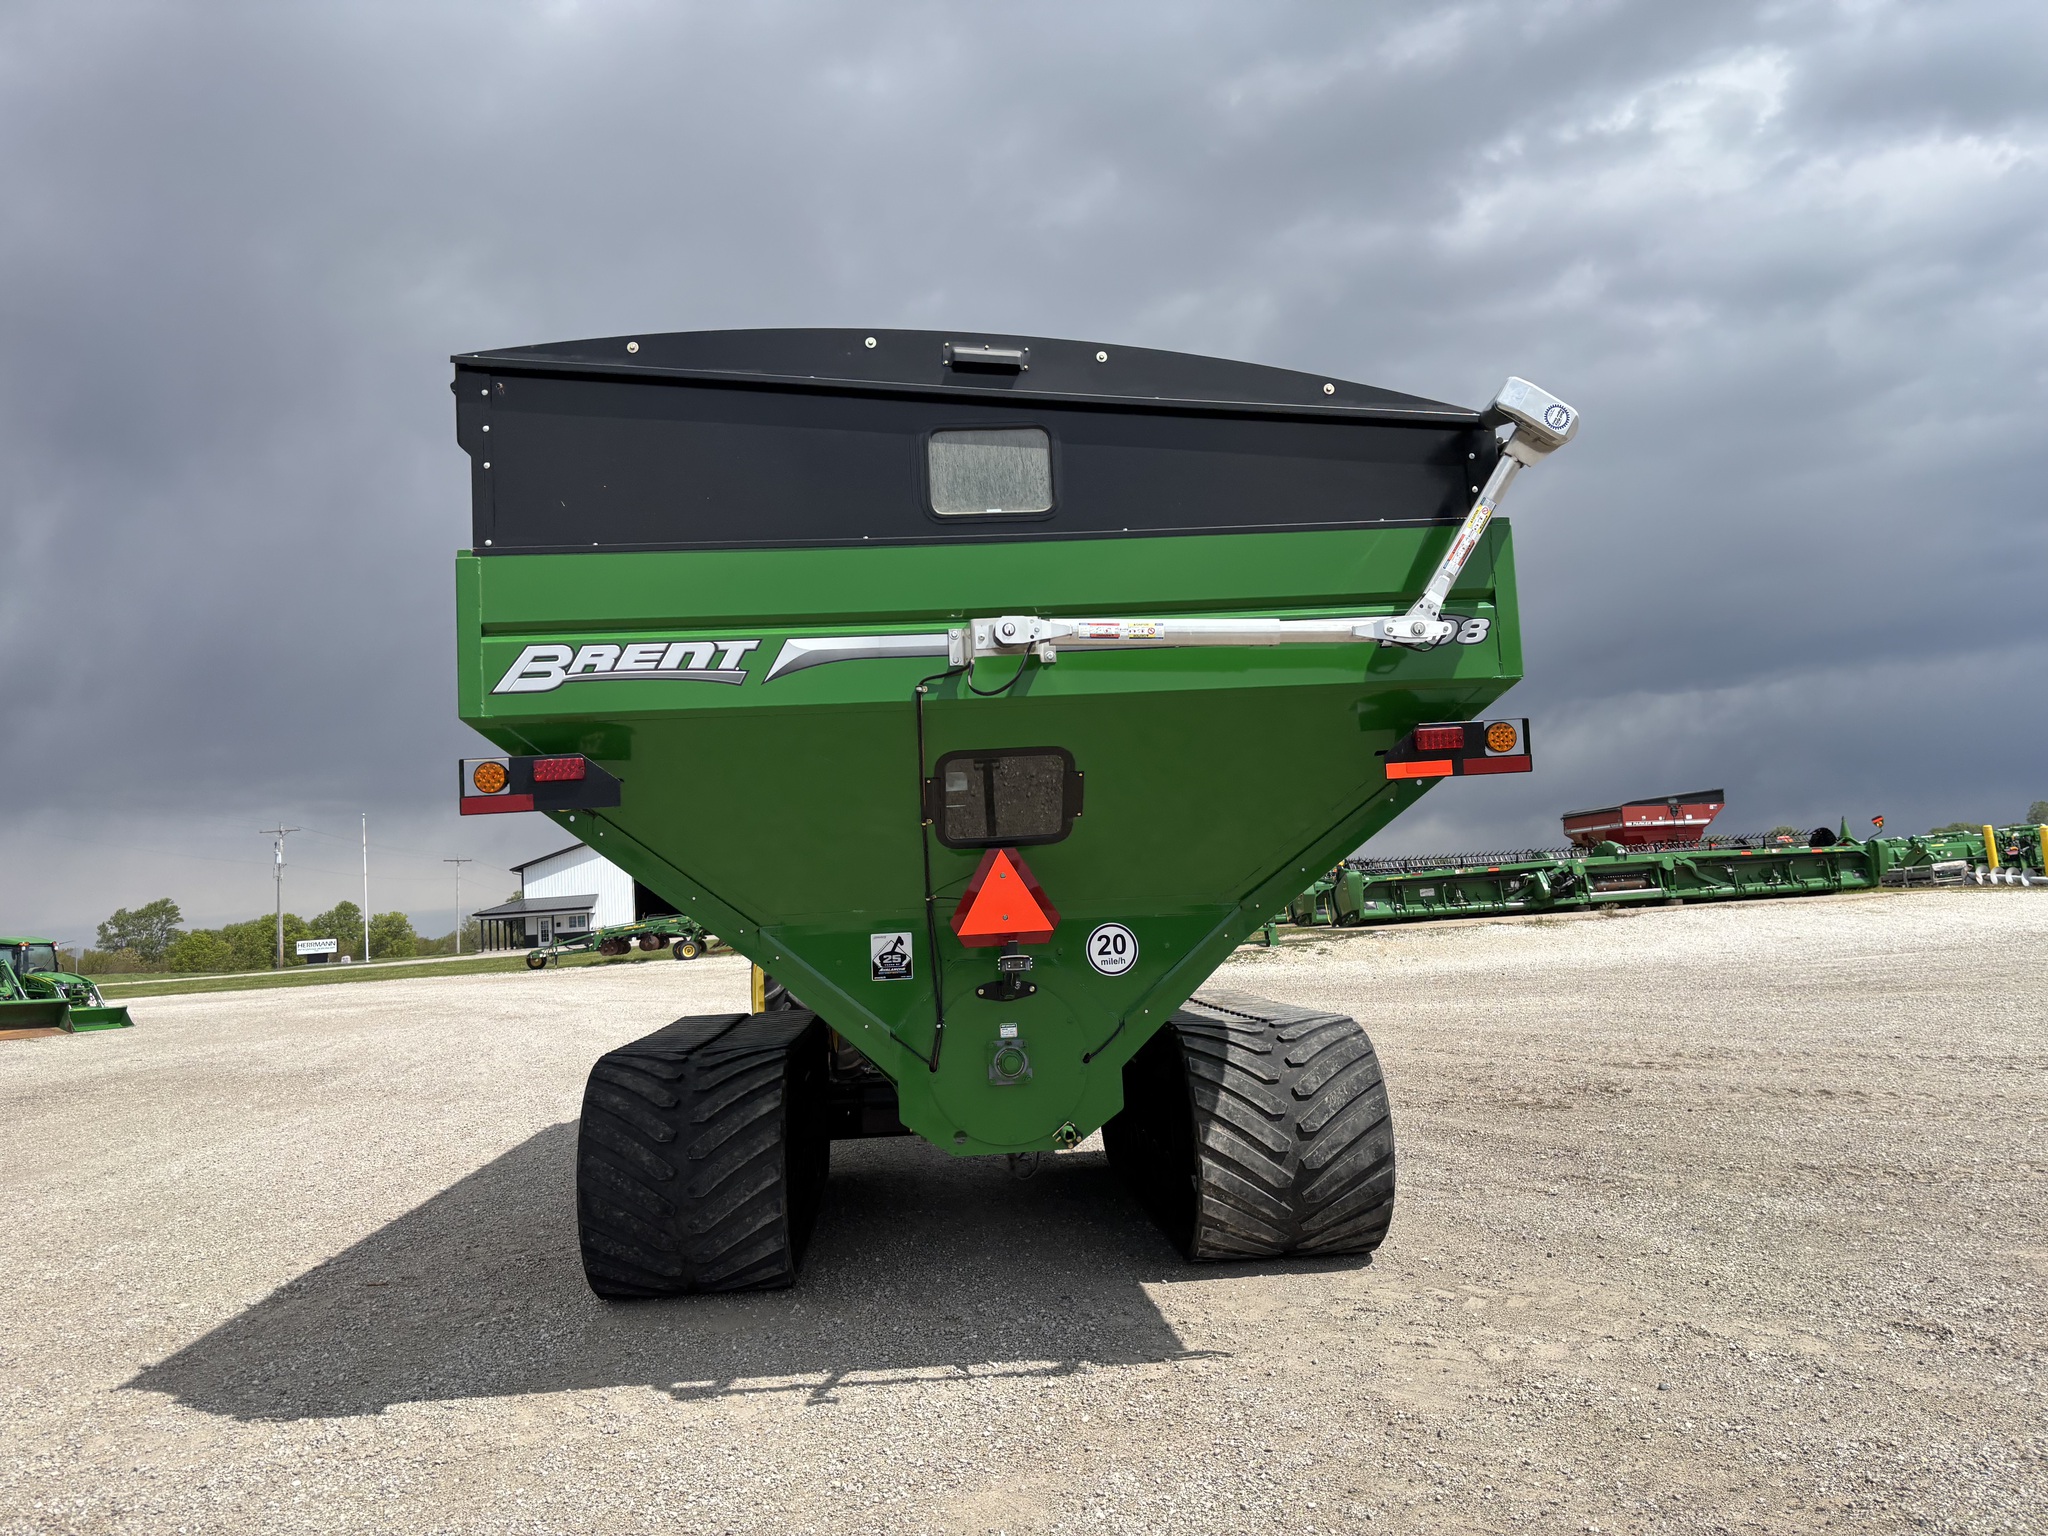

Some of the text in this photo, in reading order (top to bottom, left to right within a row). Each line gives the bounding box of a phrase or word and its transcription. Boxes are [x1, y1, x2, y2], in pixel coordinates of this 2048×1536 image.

[489, 640, 762, 694] BRENT
[1097, 933, 1127, 956] 20
[882, 954, 902, 963] 25
[1100, 957, 1126, 966] mile/h
